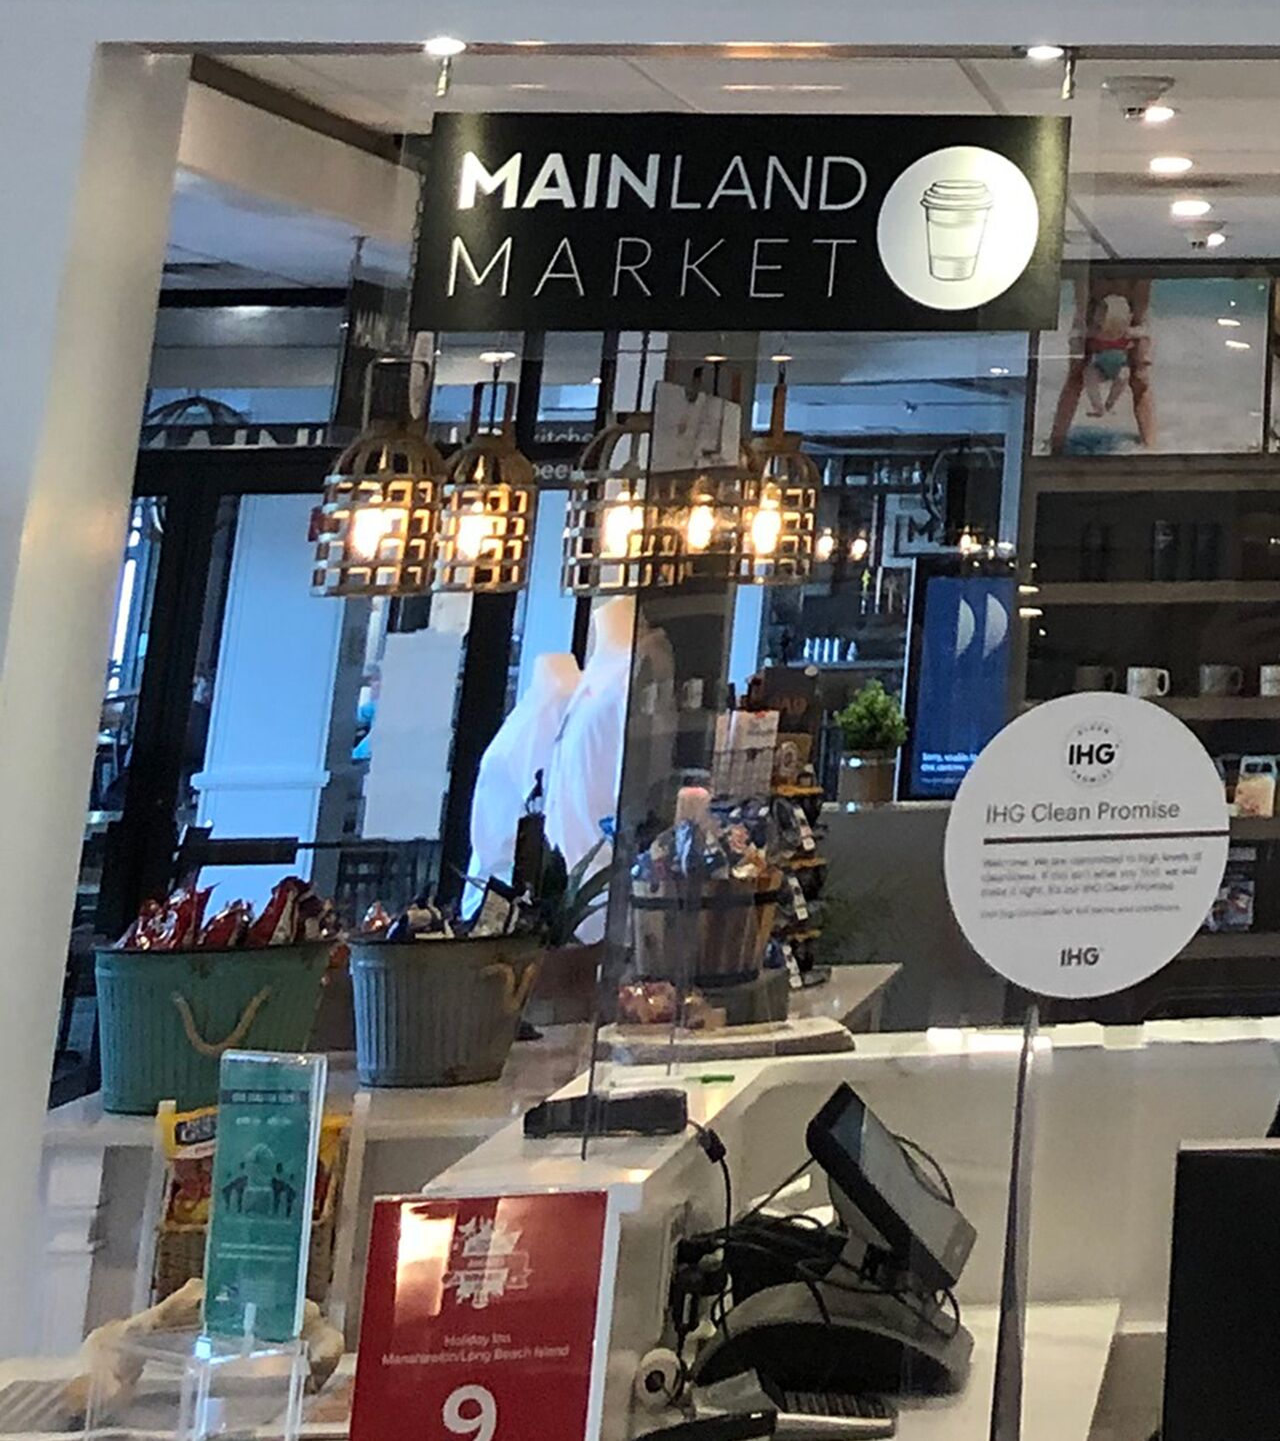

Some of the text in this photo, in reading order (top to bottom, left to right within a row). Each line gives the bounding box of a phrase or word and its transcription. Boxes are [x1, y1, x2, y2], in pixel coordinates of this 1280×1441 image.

[457, 150, 868, 212] MAINLAND
[446, 236, 858, 299] MARKET
[1067, 743, 1115, 767] IHG
[985, 800, 1180, 825] IHG Clean Promise
[1060, 947, 1100, 967] IHG
[442, 1383, 497, 1441] 9
